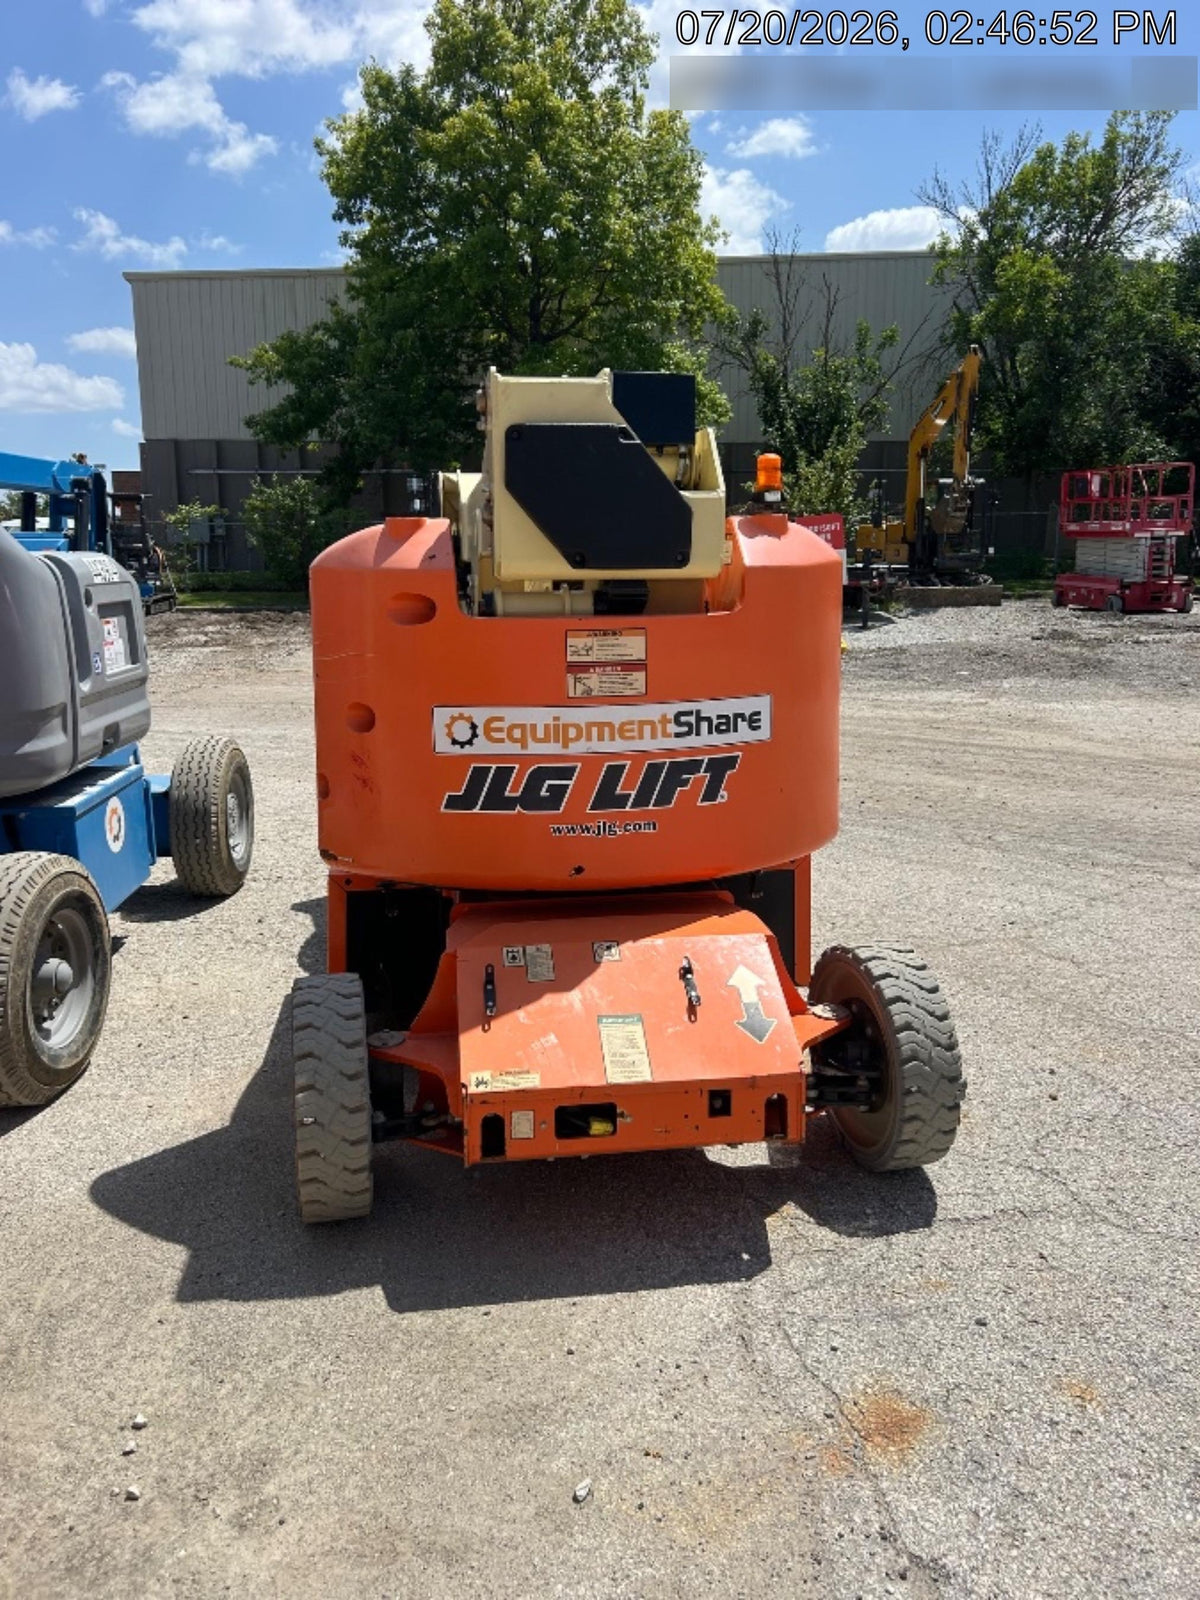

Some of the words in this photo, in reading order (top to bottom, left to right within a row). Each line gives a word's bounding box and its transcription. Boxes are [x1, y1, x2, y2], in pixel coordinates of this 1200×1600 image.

[482, 708, 763, 751] EquipmentShare
[440, 763, 582, 813] JLG
[586, 752, 742, 813] LIFT
[550, 819, 658, 838] www.jlg.com
